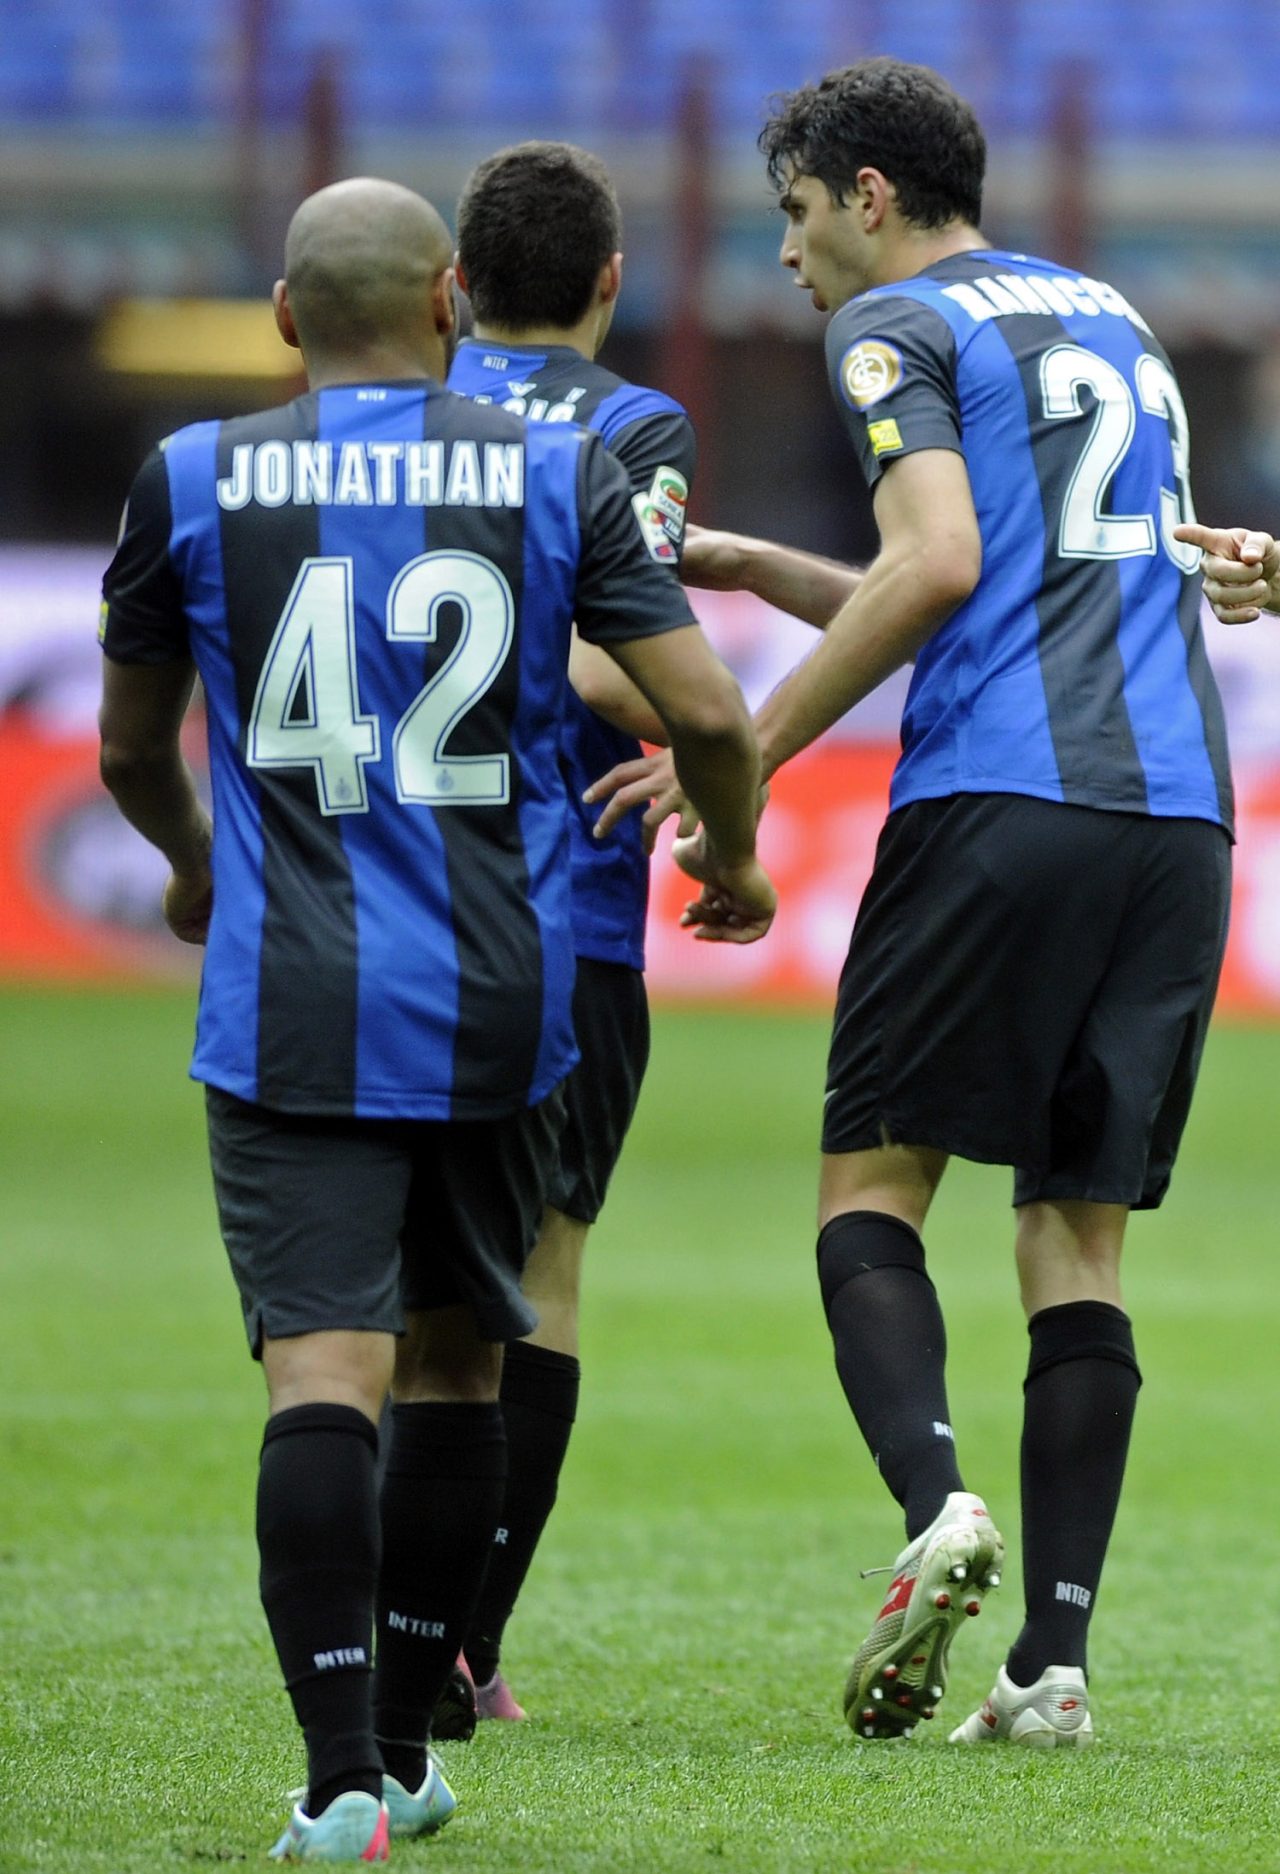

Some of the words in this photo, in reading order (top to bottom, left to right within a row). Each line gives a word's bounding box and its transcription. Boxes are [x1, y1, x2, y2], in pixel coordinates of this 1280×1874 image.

[216, 439, 525, 511] JONATHAN
[1040, 343, 1204, 576] 23
[246, 549, 515, 816] 42
[1055, 1581, 1092, 1609] INTER
[388, 1611, 446, 1639] INTER
[314, 1647, 366, 1670] INTER
